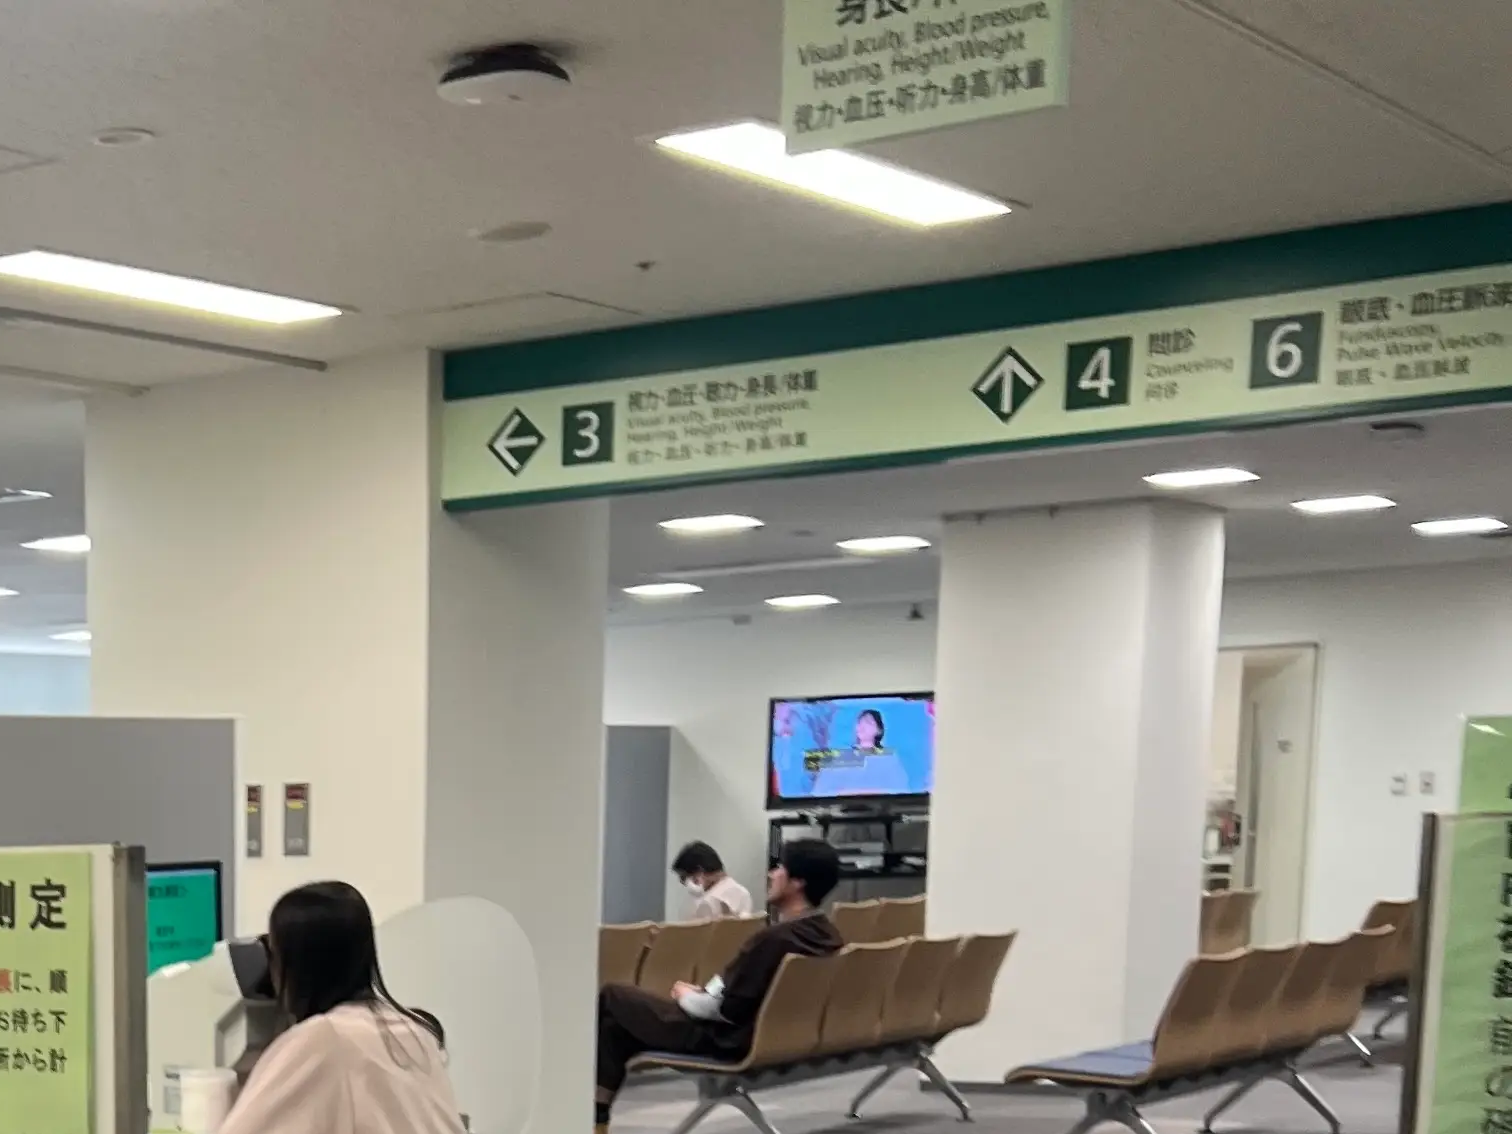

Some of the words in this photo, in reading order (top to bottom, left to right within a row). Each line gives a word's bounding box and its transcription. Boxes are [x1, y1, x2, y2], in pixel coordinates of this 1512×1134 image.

[913, 10, 965, 44] Blood
[1078, 347, 1115, 398] 4
[1267, 322, 1304, 379] 6
[572, 409, 600, 459] 3
